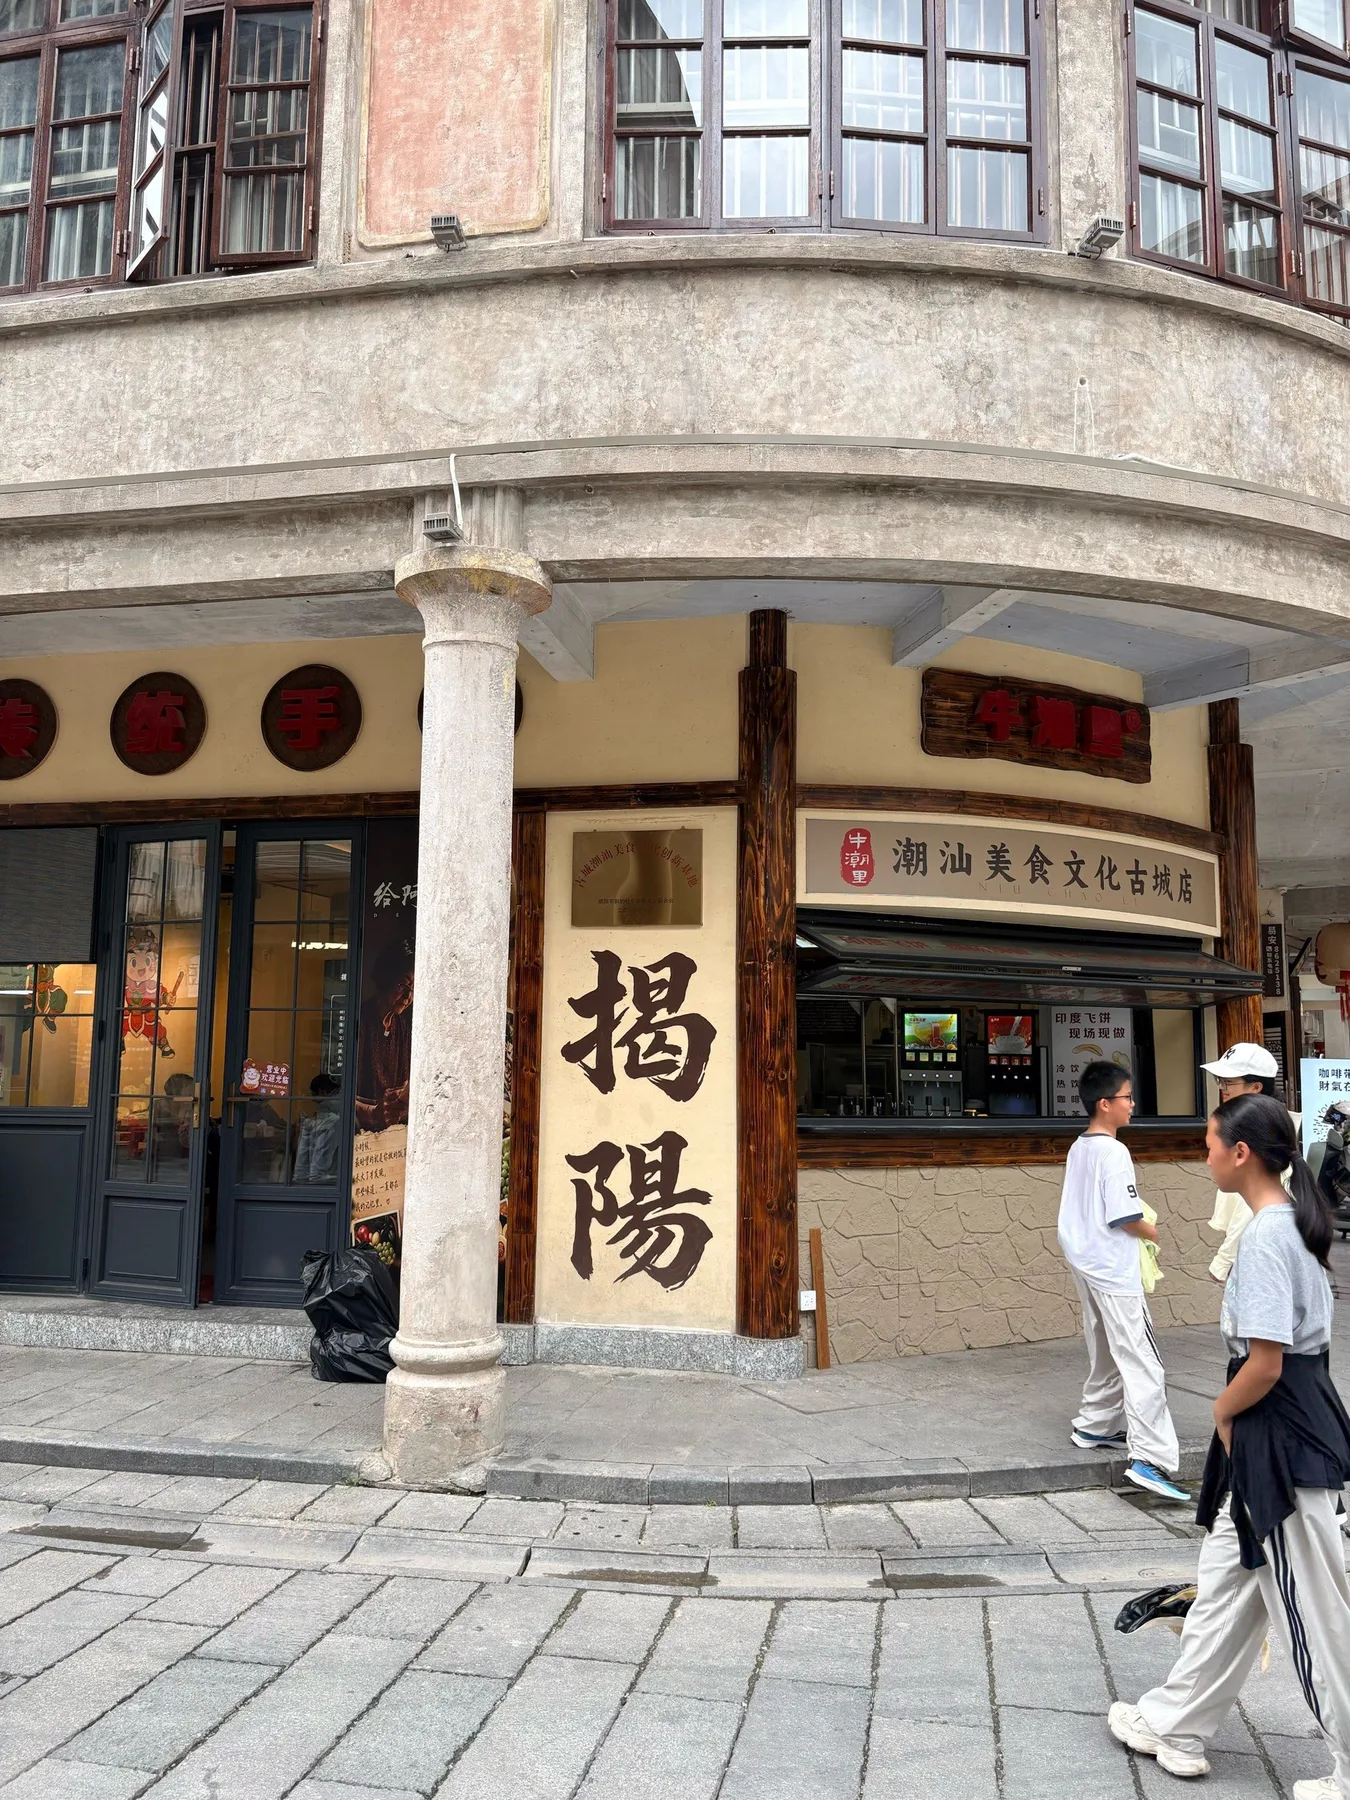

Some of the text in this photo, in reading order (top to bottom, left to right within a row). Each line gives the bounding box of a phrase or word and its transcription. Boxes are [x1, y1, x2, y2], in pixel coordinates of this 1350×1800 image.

[575, 841, 699, 888] 古城潮汕美食化创新基地
[892, 838, 1193, 905] 潮汕美食文化古城店
[978, 882, 1022, 896] NIU
[1055, 1012, 1111, 1024] 印度飞饼
[1069, 1027, 1125, 1039] 现场现做
[1056, 1064, 1080, 1073] 冷饮
[1056, 1080, 1080, 1088] 热饮
[561, 950, 717, 1293] 揭陽
[1127, 1184, 1137, 1199] 9
